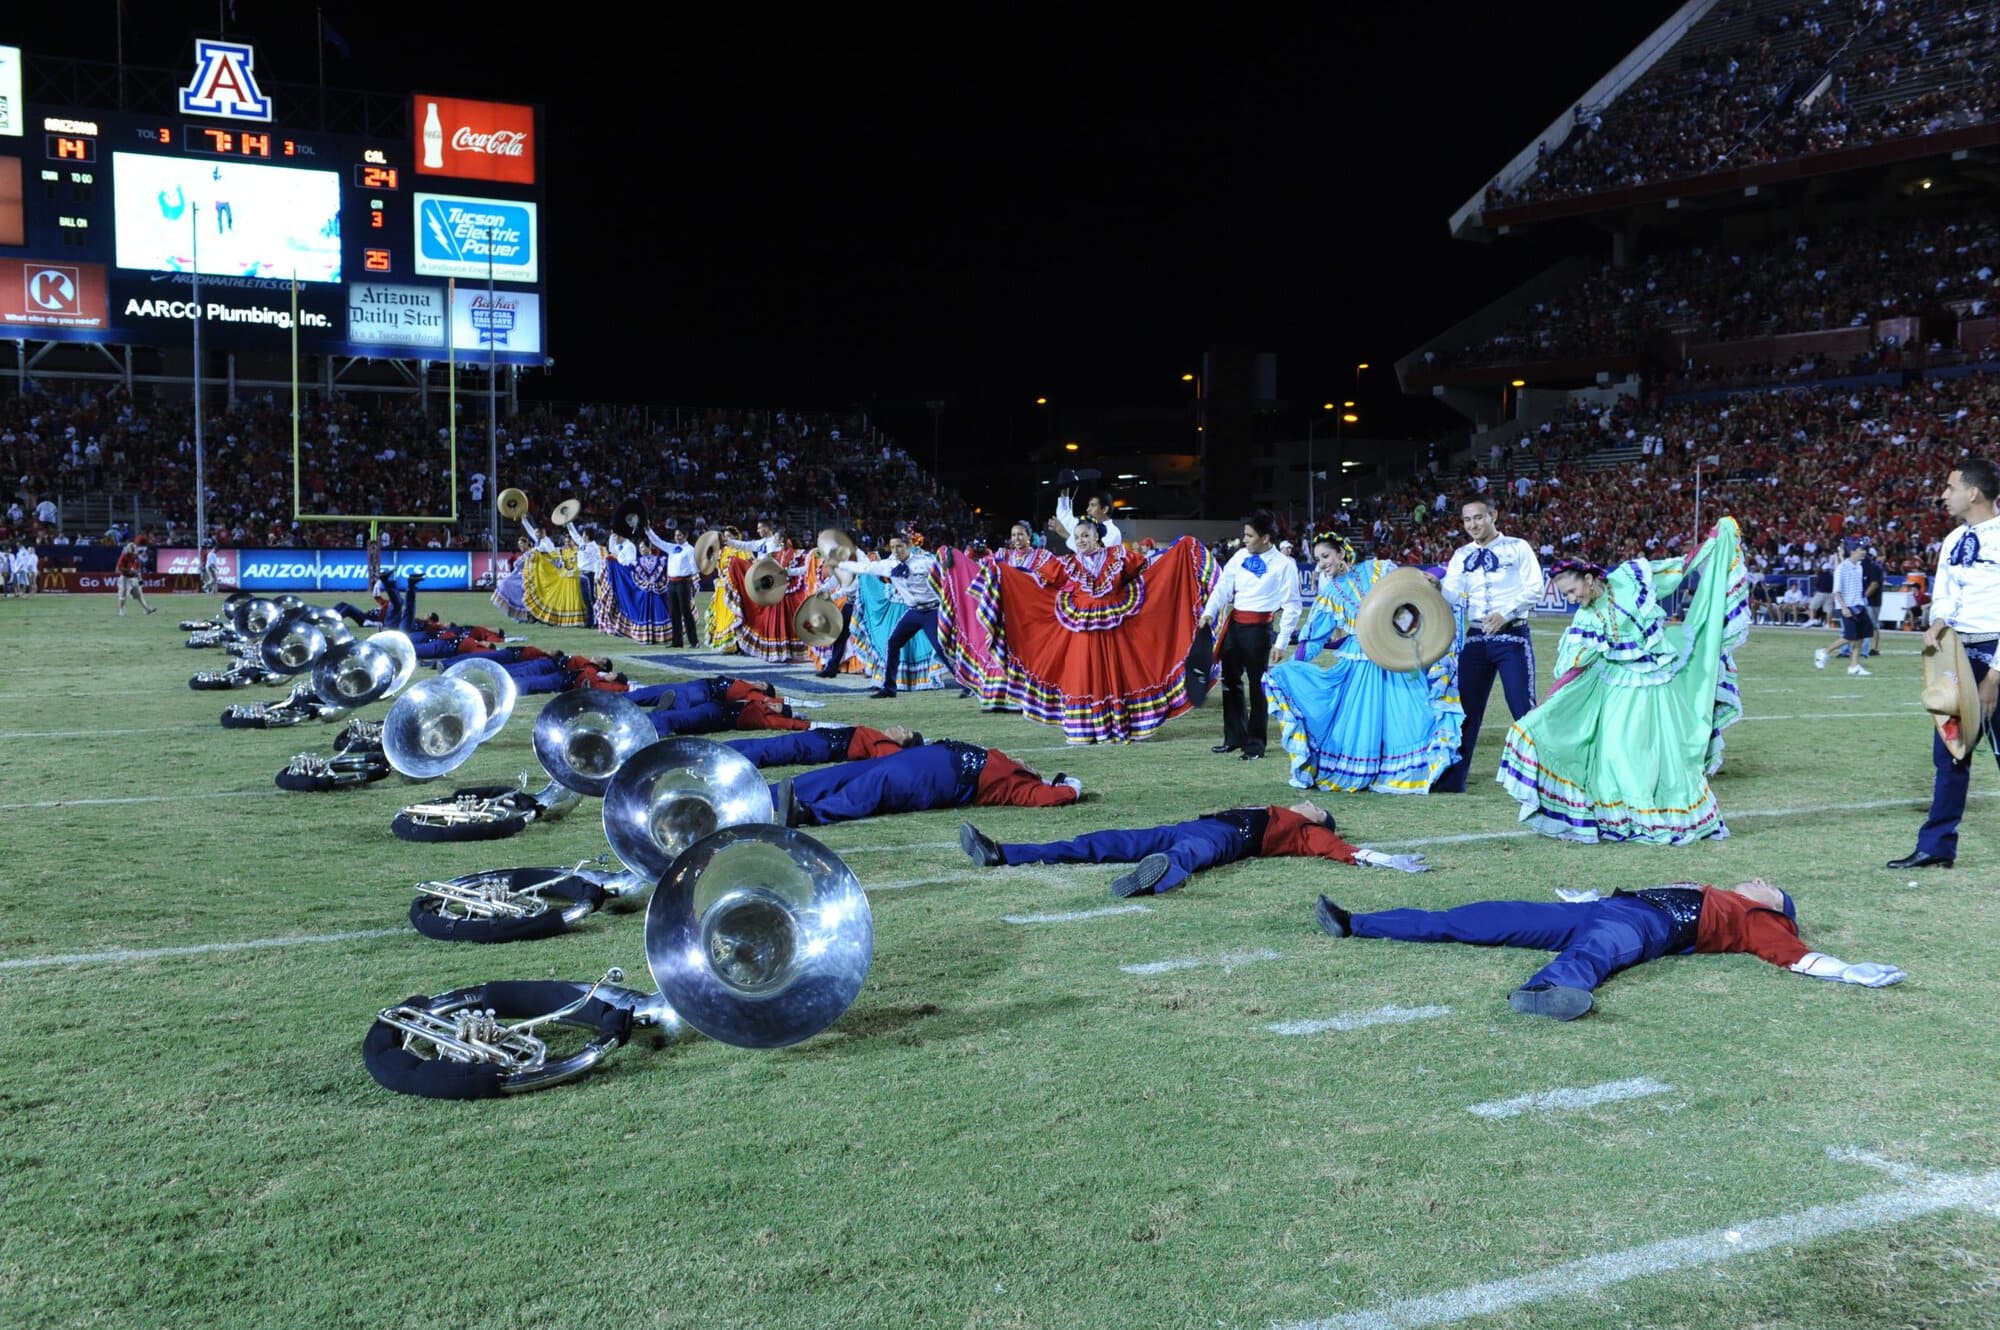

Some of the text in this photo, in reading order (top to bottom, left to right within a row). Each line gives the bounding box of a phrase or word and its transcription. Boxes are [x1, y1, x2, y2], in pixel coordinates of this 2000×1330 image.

[179, 38, 272, 122] A
[137, 129, 157, 140] TOL
[159, 128, 170, 143] 3
[452, 126, 527, 156] Coca-Cola
[284, 141, 295, 155] 3
[296, 144, 316, 155] TOL
[364, 167, 397, 188] 24
[371, 211, 383, 228] 3
[448, 207, 505, 227] Tucson
[454, 223, 521, 243] Electric
[461, 239, 521, 257] Power
[366, 251, 389, 270] 25
[360, 286, 431, 307] Arizona
[125, 299, 201, 319] AARCO
[300, 309, 332, 327] Inc.
[349, 305, 442, 328] Daily Star
[80, 577, 99, 587] Go
